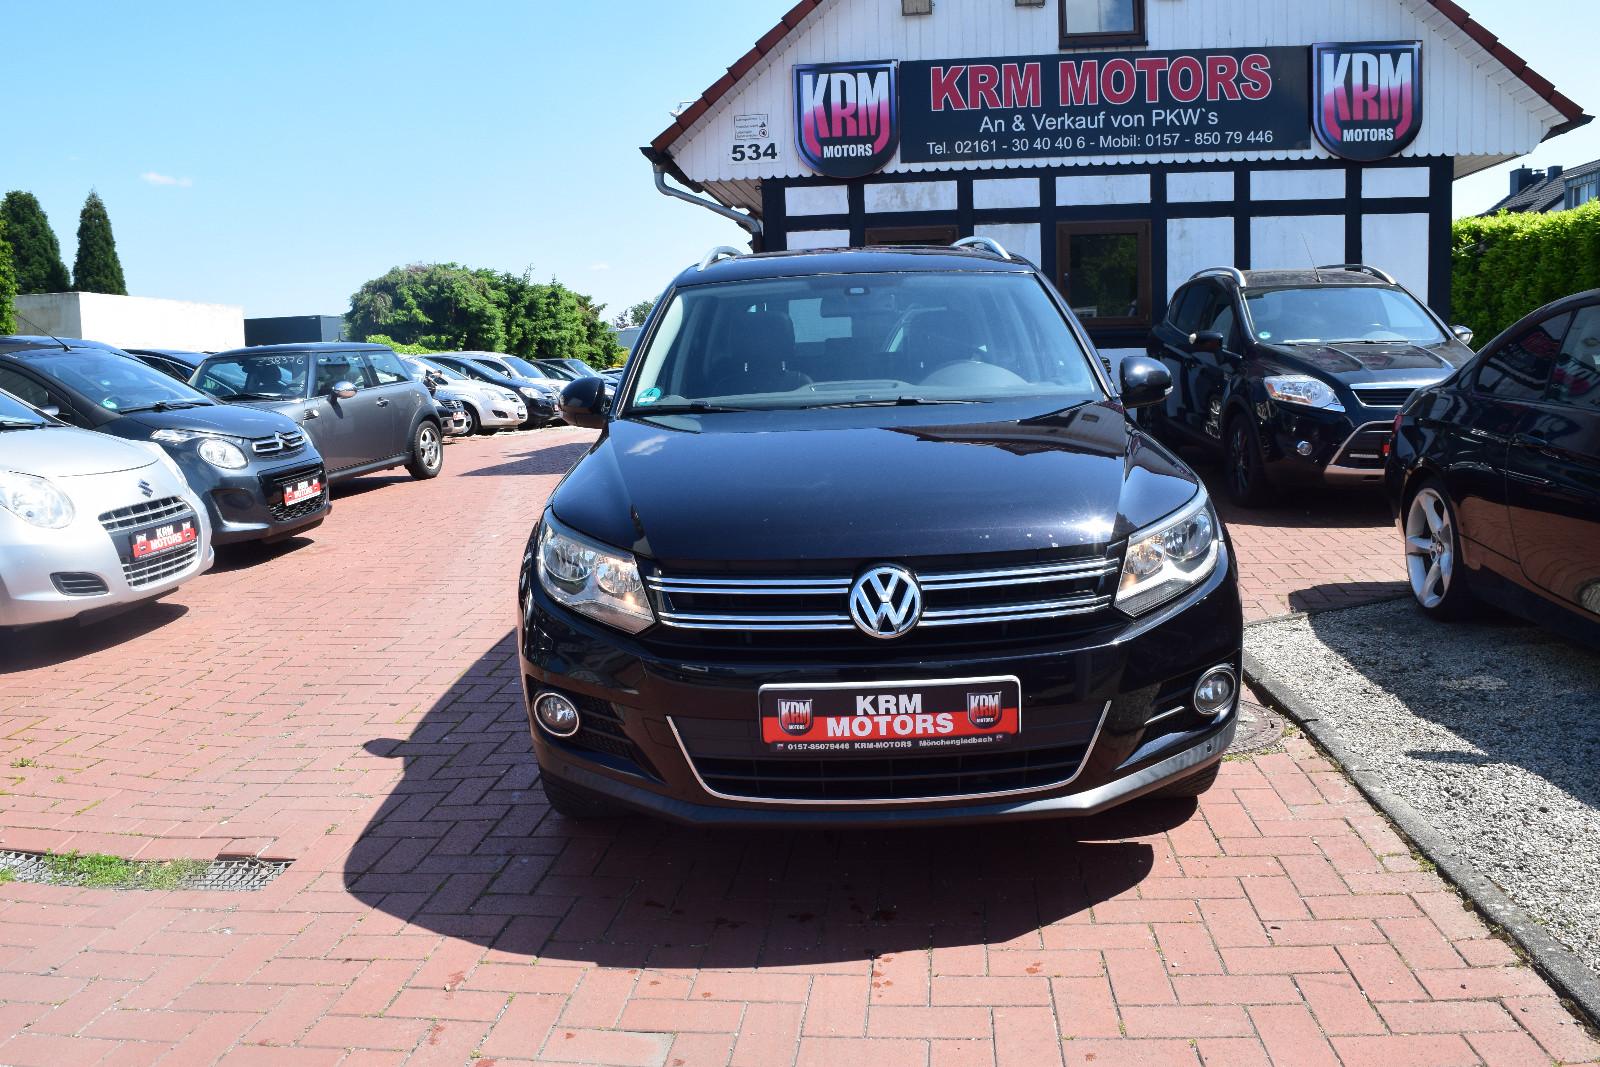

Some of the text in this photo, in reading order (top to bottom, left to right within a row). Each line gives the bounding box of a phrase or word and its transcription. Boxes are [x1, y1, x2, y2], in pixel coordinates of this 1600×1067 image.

[931, 54, 1273, 112] KRM MOTORS
[1323, 53, 1412, 141] KRM
[803, 72, 890, 157] KRM
[980, 116, 1005, 132] An
[1012, 115, 1025, 131] &
[1032, 111, 1106, 131] Verkauf
[1111, 113, 1144, 128] von
[927, 142, 950, 154] Tel.
[955, 140, 997, 154] 02161
[1012, 138, 1029, 151] 30
[1033, 137, 1050, 150] 40
[1055, 137, 1072, 149] 40
[1076, 136, 1086, 149] 6
[1100, 135, 1141, 148] Mobil:
[1145, 133, 1180, 147] 0157
[1194, 132, 1221, 145] 850
[1225, 131, 1243, 144] 79
[1246, 130, 1273, 143] 446
[1343, 127, 1394, 142] MOTORS
[731, 143, 778, 161] 534
[823, 144, 872, 158] MOTORS
[151, 532, 183, 550] MOTORS
[156, 524, 174, 538] KRM
[856, 694, 922, 716] KRM
[827, 713, 954, 737] MOTORS
[855, 740, 913, 749] KRM-MOTORS
